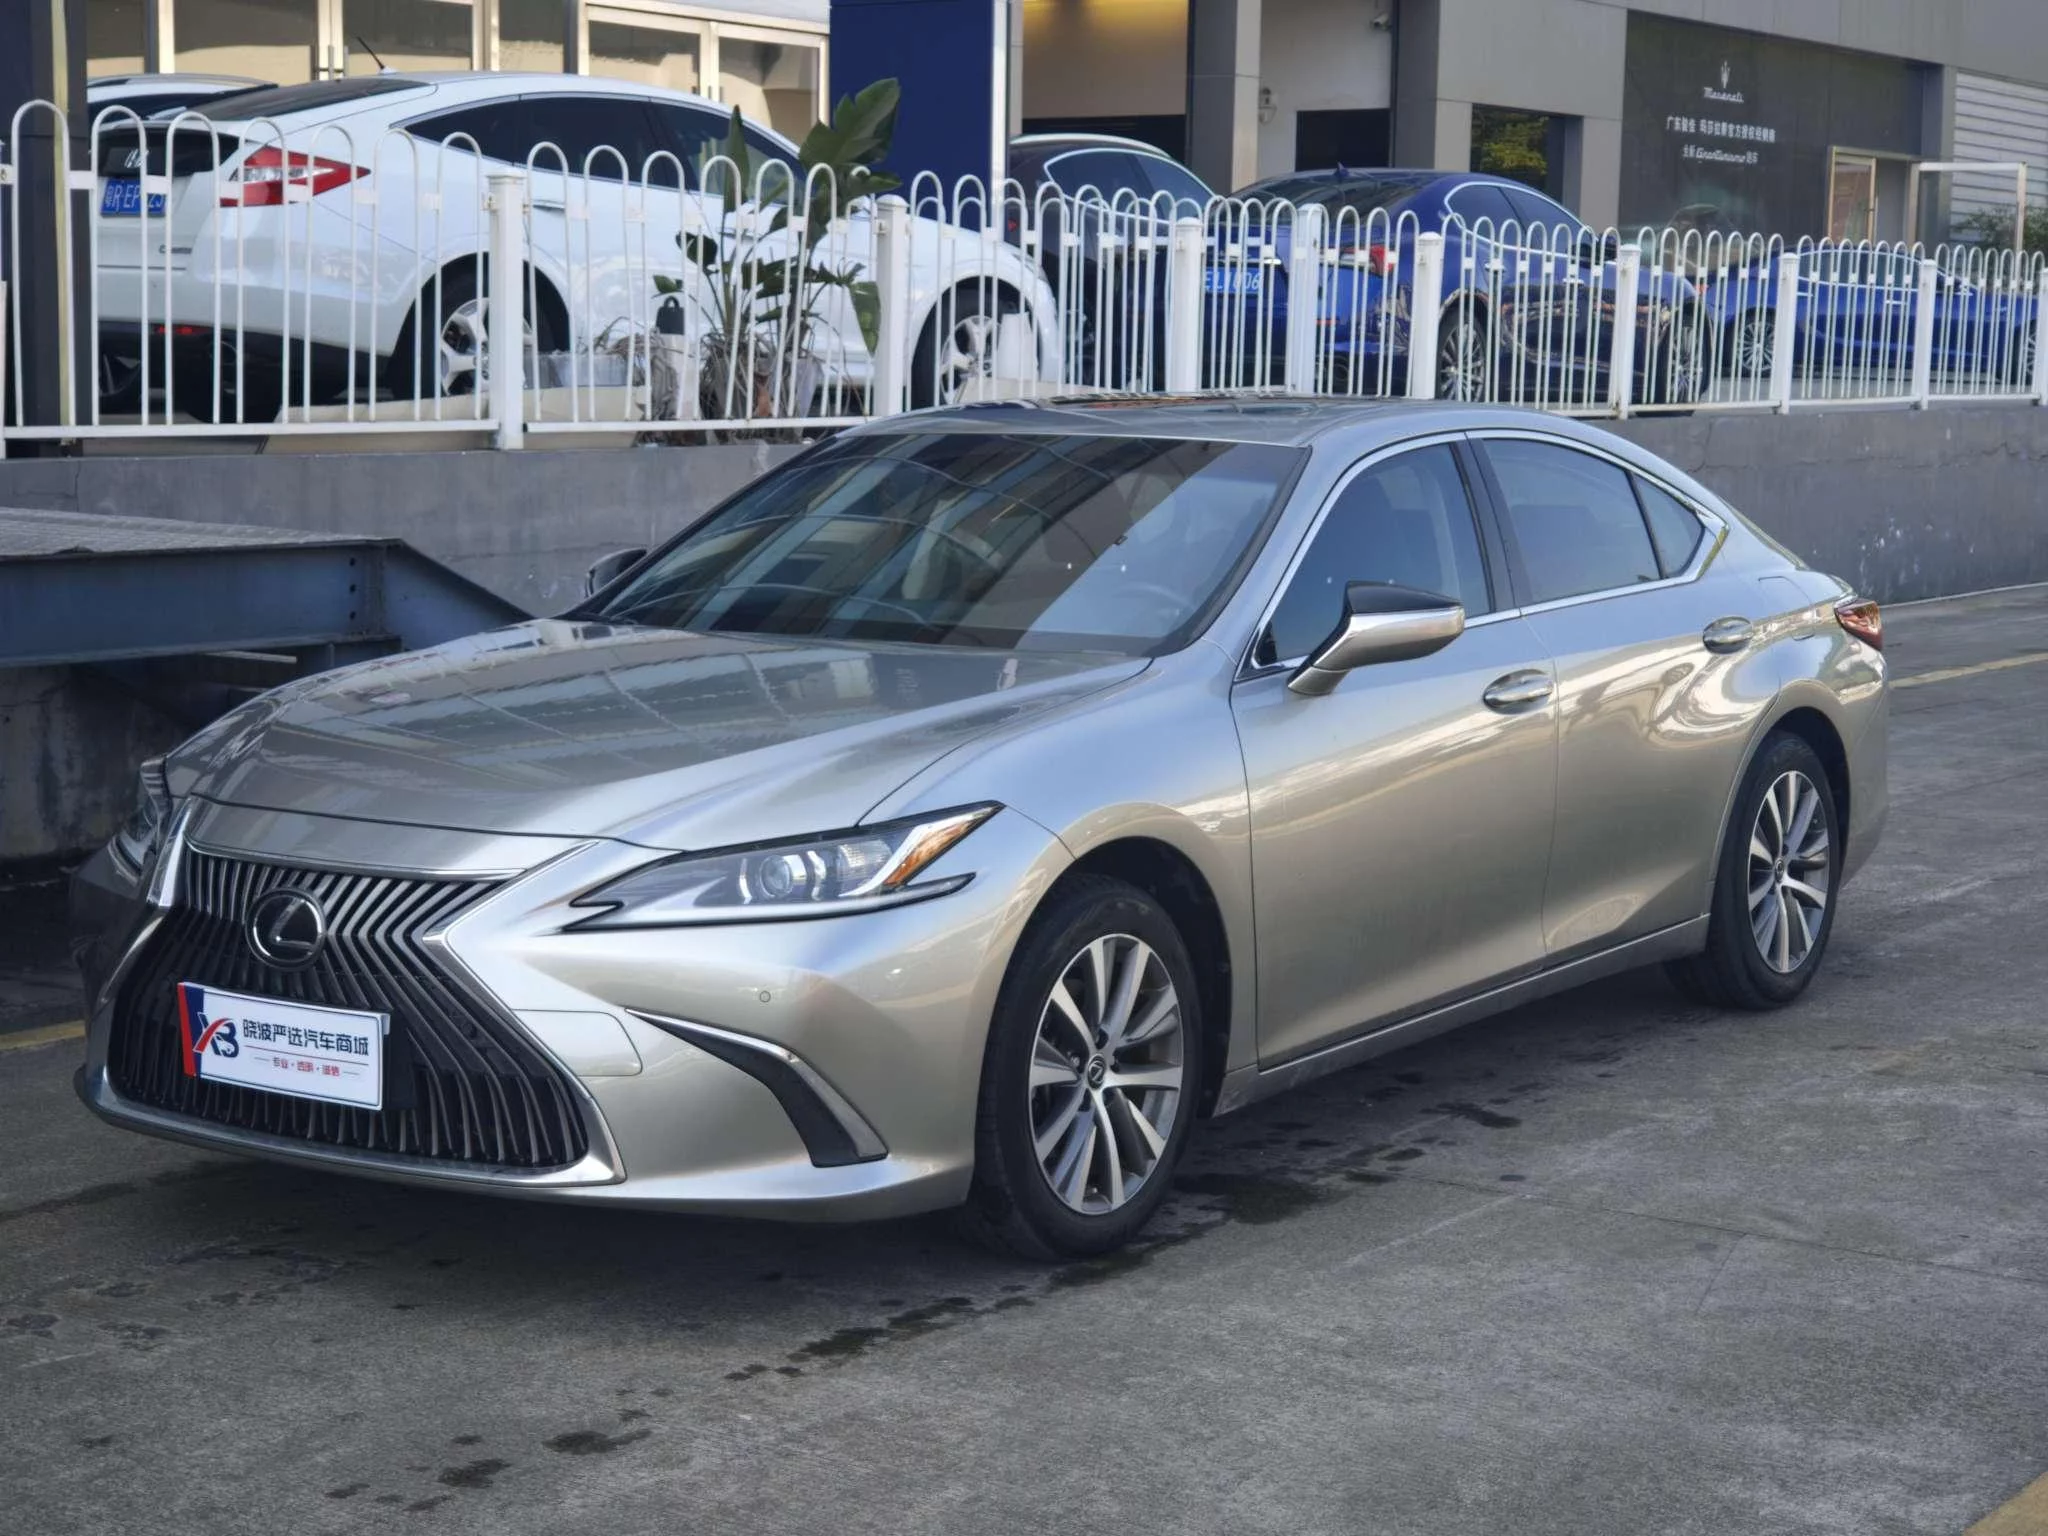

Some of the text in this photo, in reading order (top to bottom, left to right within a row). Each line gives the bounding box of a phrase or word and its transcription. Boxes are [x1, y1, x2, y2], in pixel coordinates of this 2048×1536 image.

[243, 1018, 369, 1056] 晓波严选汽车商城
